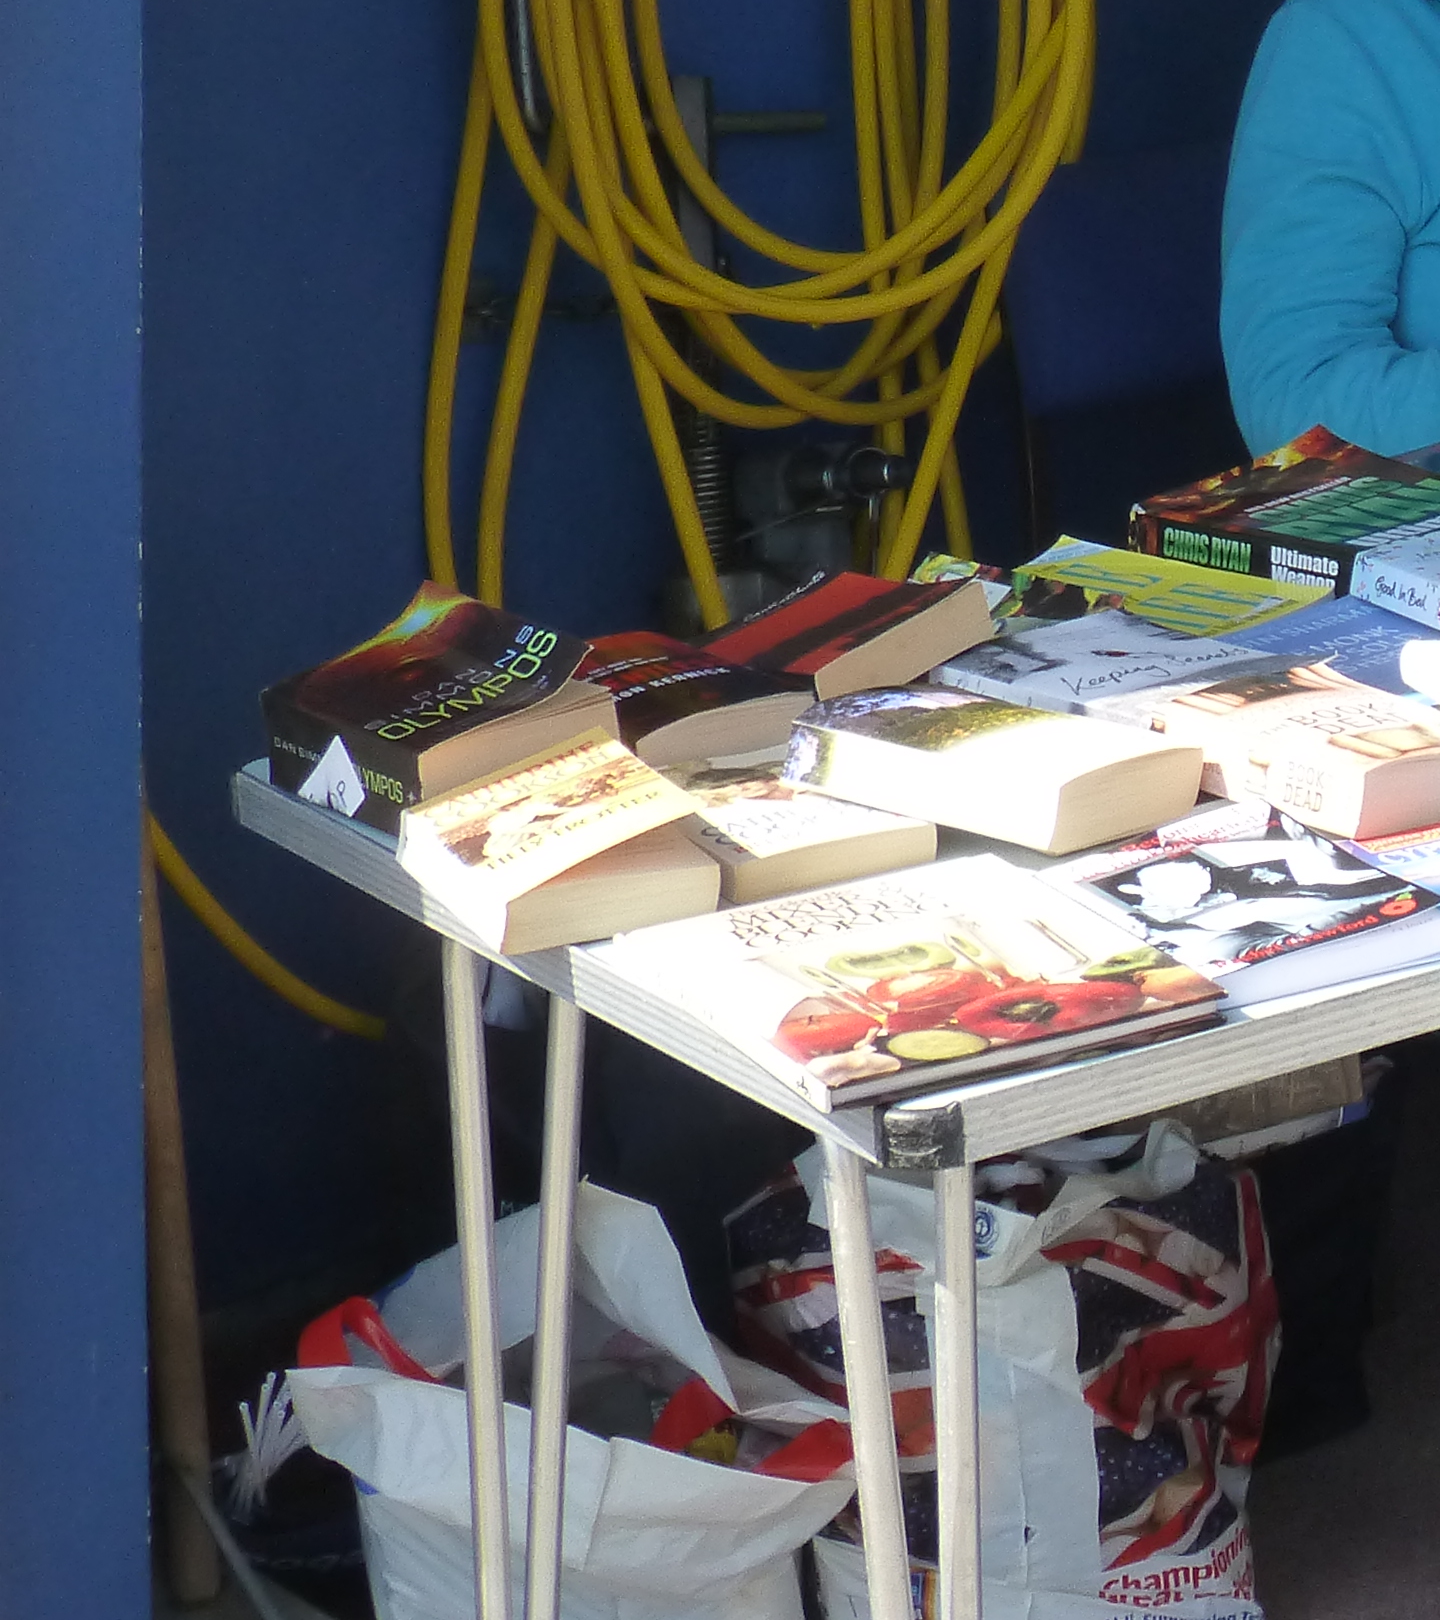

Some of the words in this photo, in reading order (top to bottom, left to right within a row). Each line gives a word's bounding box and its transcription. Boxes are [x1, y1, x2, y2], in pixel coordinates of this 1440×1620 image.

[1163, 527, 1209, 566] CHRIS
[1210, 536, 1252, 574] RYAN
[1270, 545, 1339, 576] Ultimate
[1271, 565, 1336, 588] Weapon
[1374, 575, 1397, 599] Good
[1407, 587, 1428, 612] Bed
[377, 629, 558, 741] OLYMPOS
[1060, 661, 1170, 696] Keeping
[1288, 702, 1382, 727] BOOK
[1287, 760, 1326, 789] BOOK
[1282, 782, 1323, 813] DEAD
[728, 893, 860, 931] MIXER
[1285, 914, 1379, 948] Crawford
[1101, 1526, 1251, 1592] Championin
